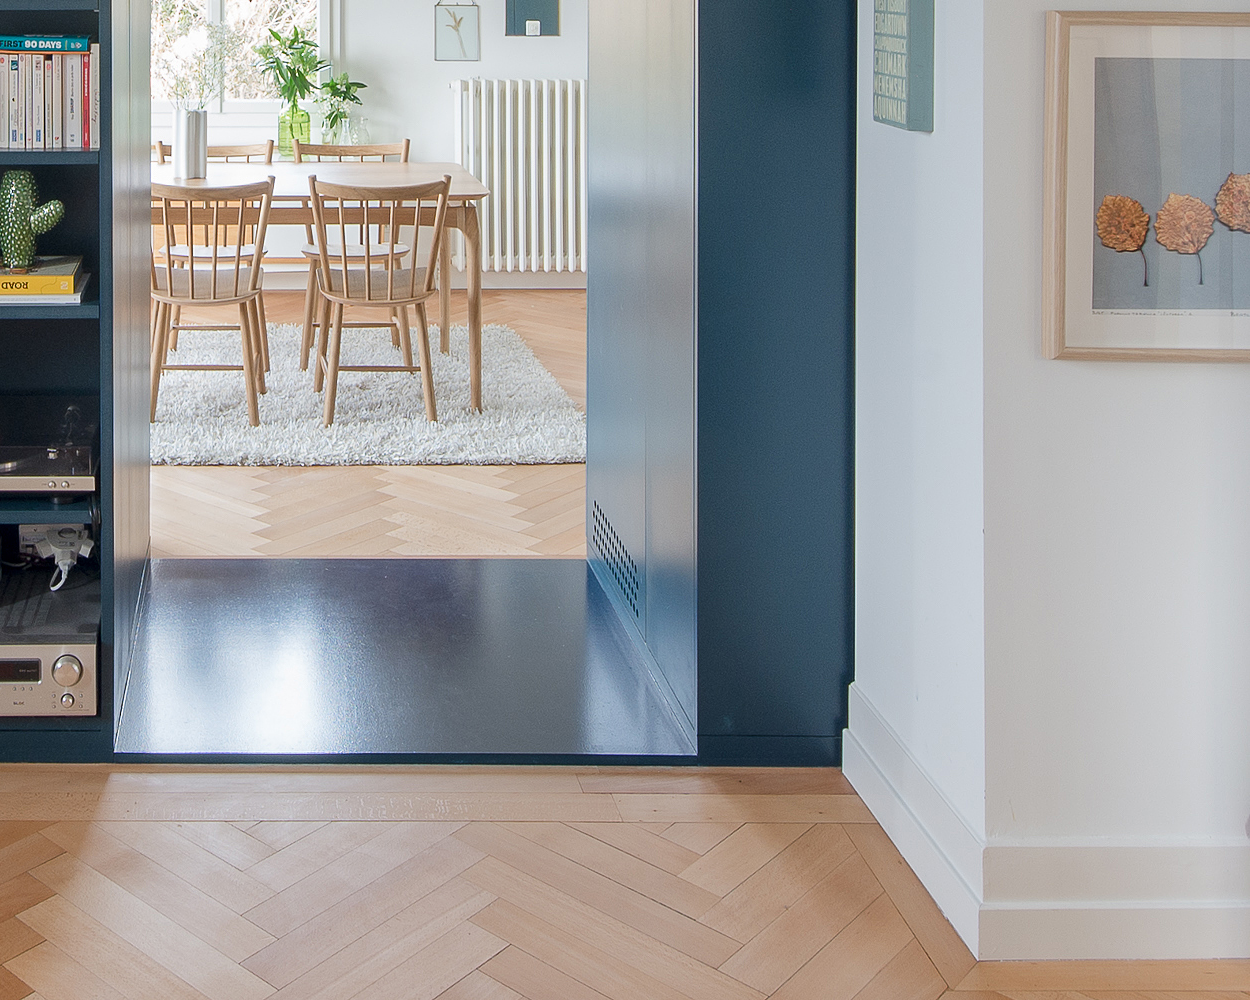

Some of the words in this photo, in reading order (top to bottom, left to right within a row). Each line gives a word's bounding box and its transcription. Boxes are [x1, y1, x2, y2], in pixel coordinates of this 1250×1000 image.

[875, 13, 908, 36] EDGARTOWN
[24, 40, 38, 48] 90
[38, 40, 61, 49] DAYS
[874, 50, 908, 77] CHILMARK
[874, 94, 908, 124] AQUINNAH
[1, 281, 28, 290] ROAD
